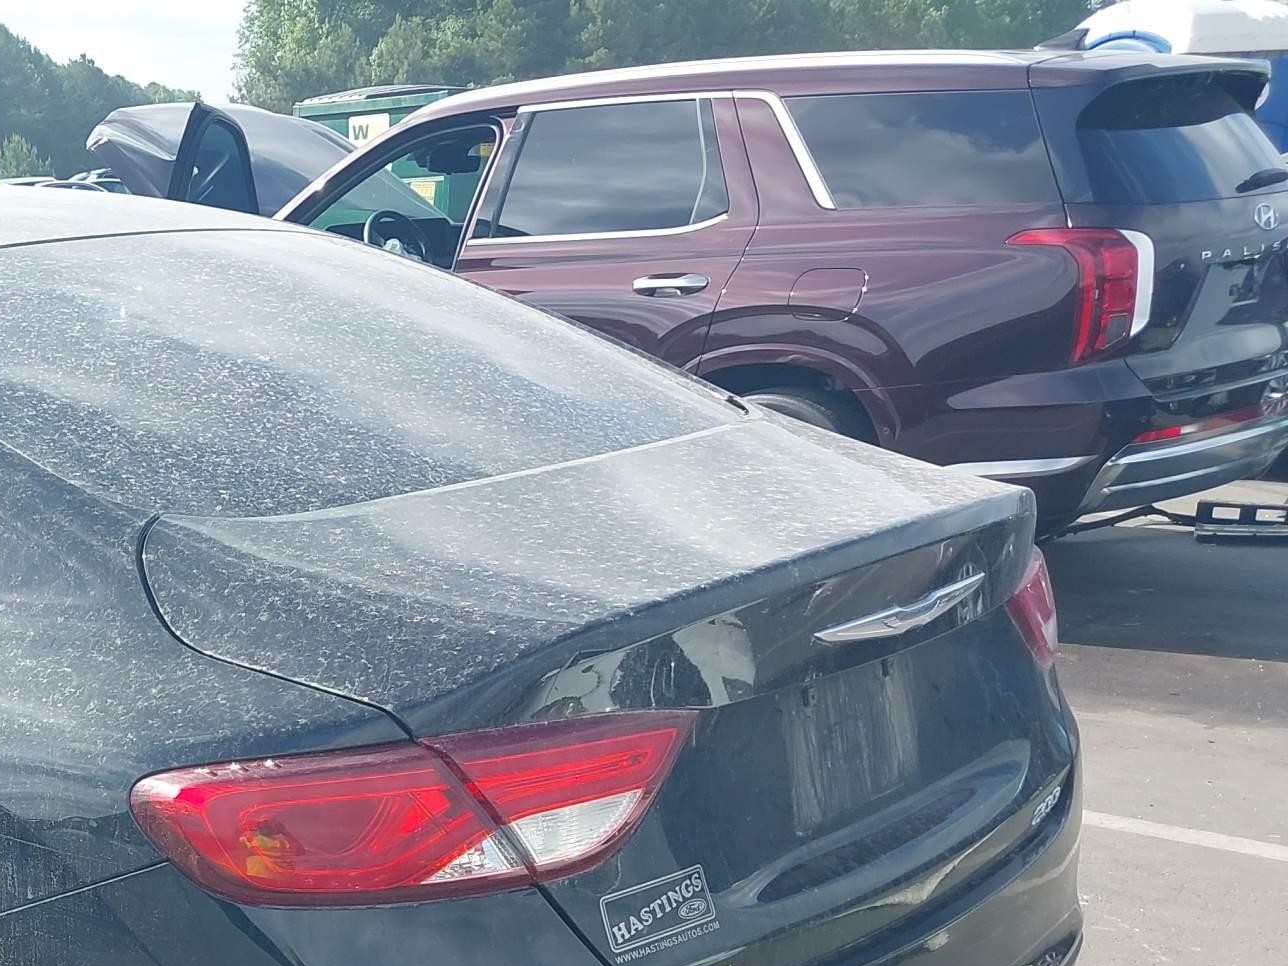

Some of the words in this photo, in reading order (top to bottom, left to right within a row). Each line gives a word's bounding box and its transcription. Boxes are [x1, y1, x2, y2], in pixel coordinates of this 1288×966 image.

[1201, 241, 1288, 260] PALIS
[1032, 786, 1061, 825] 200
[612, 873, 702, 944] HASTINGS
[615, 920, 721, 965] WWW.HASTINGSAUTOS.COM
